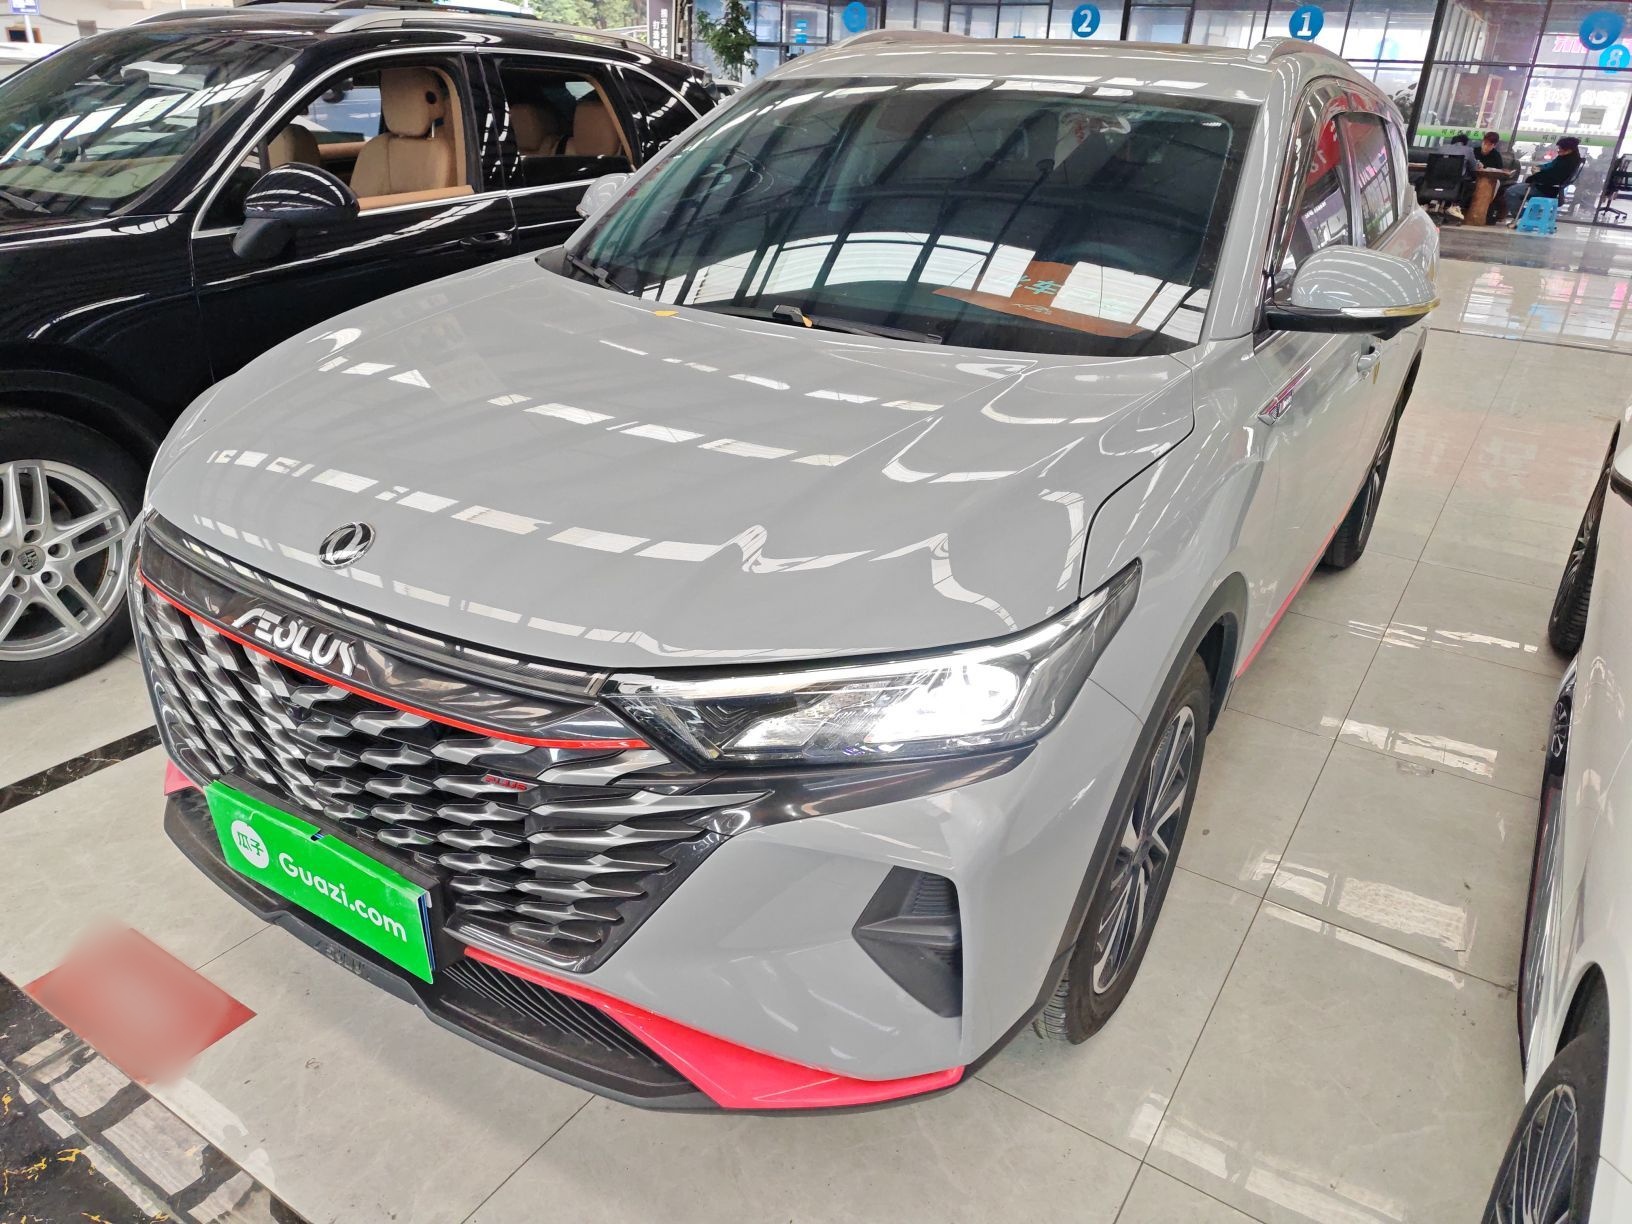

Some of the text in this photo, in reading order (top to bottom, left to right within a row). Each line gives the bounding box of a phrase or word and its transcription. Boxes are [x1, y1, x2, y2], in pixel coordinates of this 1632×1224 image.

[1077, 9, 1093, 33] 2
[1296, 11, 1313, 36] 1
[236, 831, 264, 857] 瓜子
[278, 852, 408, 943] Guazi.com
